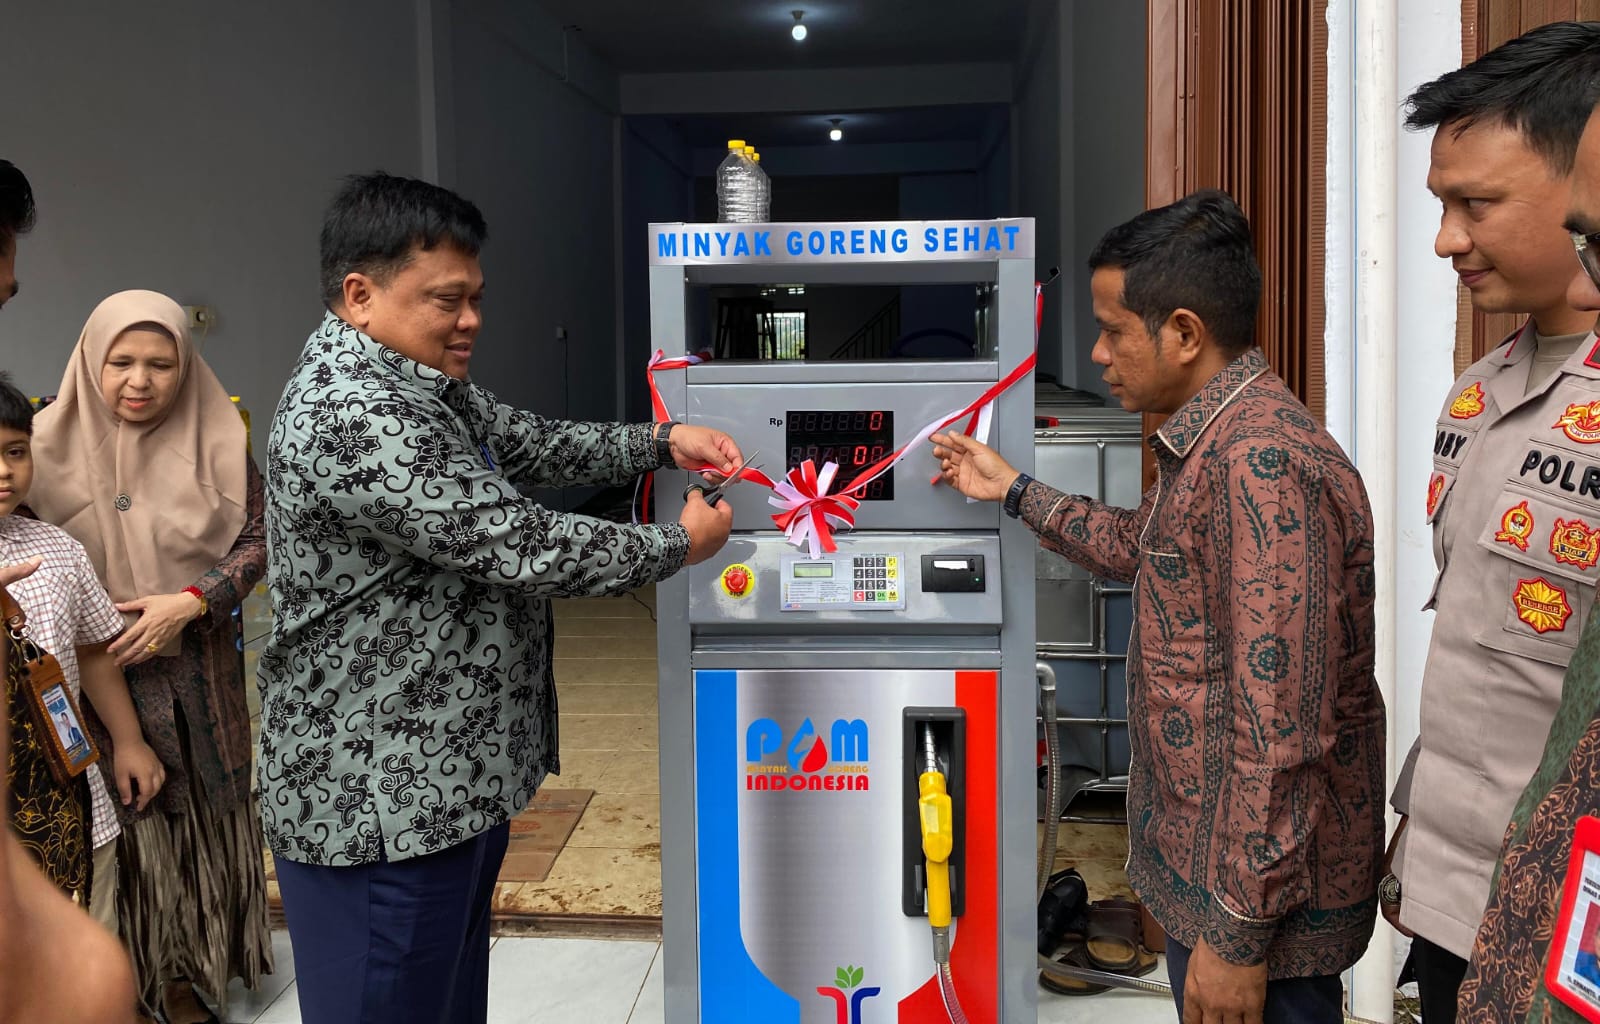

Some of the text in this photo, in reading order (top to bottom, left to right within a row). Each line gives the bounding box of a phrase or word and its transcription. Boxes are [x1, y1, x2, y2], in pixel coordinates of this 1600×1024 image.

[658, 226, 1020, 257] MINYAK GORENG SEHAT
[769, 417, 784, 428] Rp
[746, 774, 870, 791] INDONESIA
